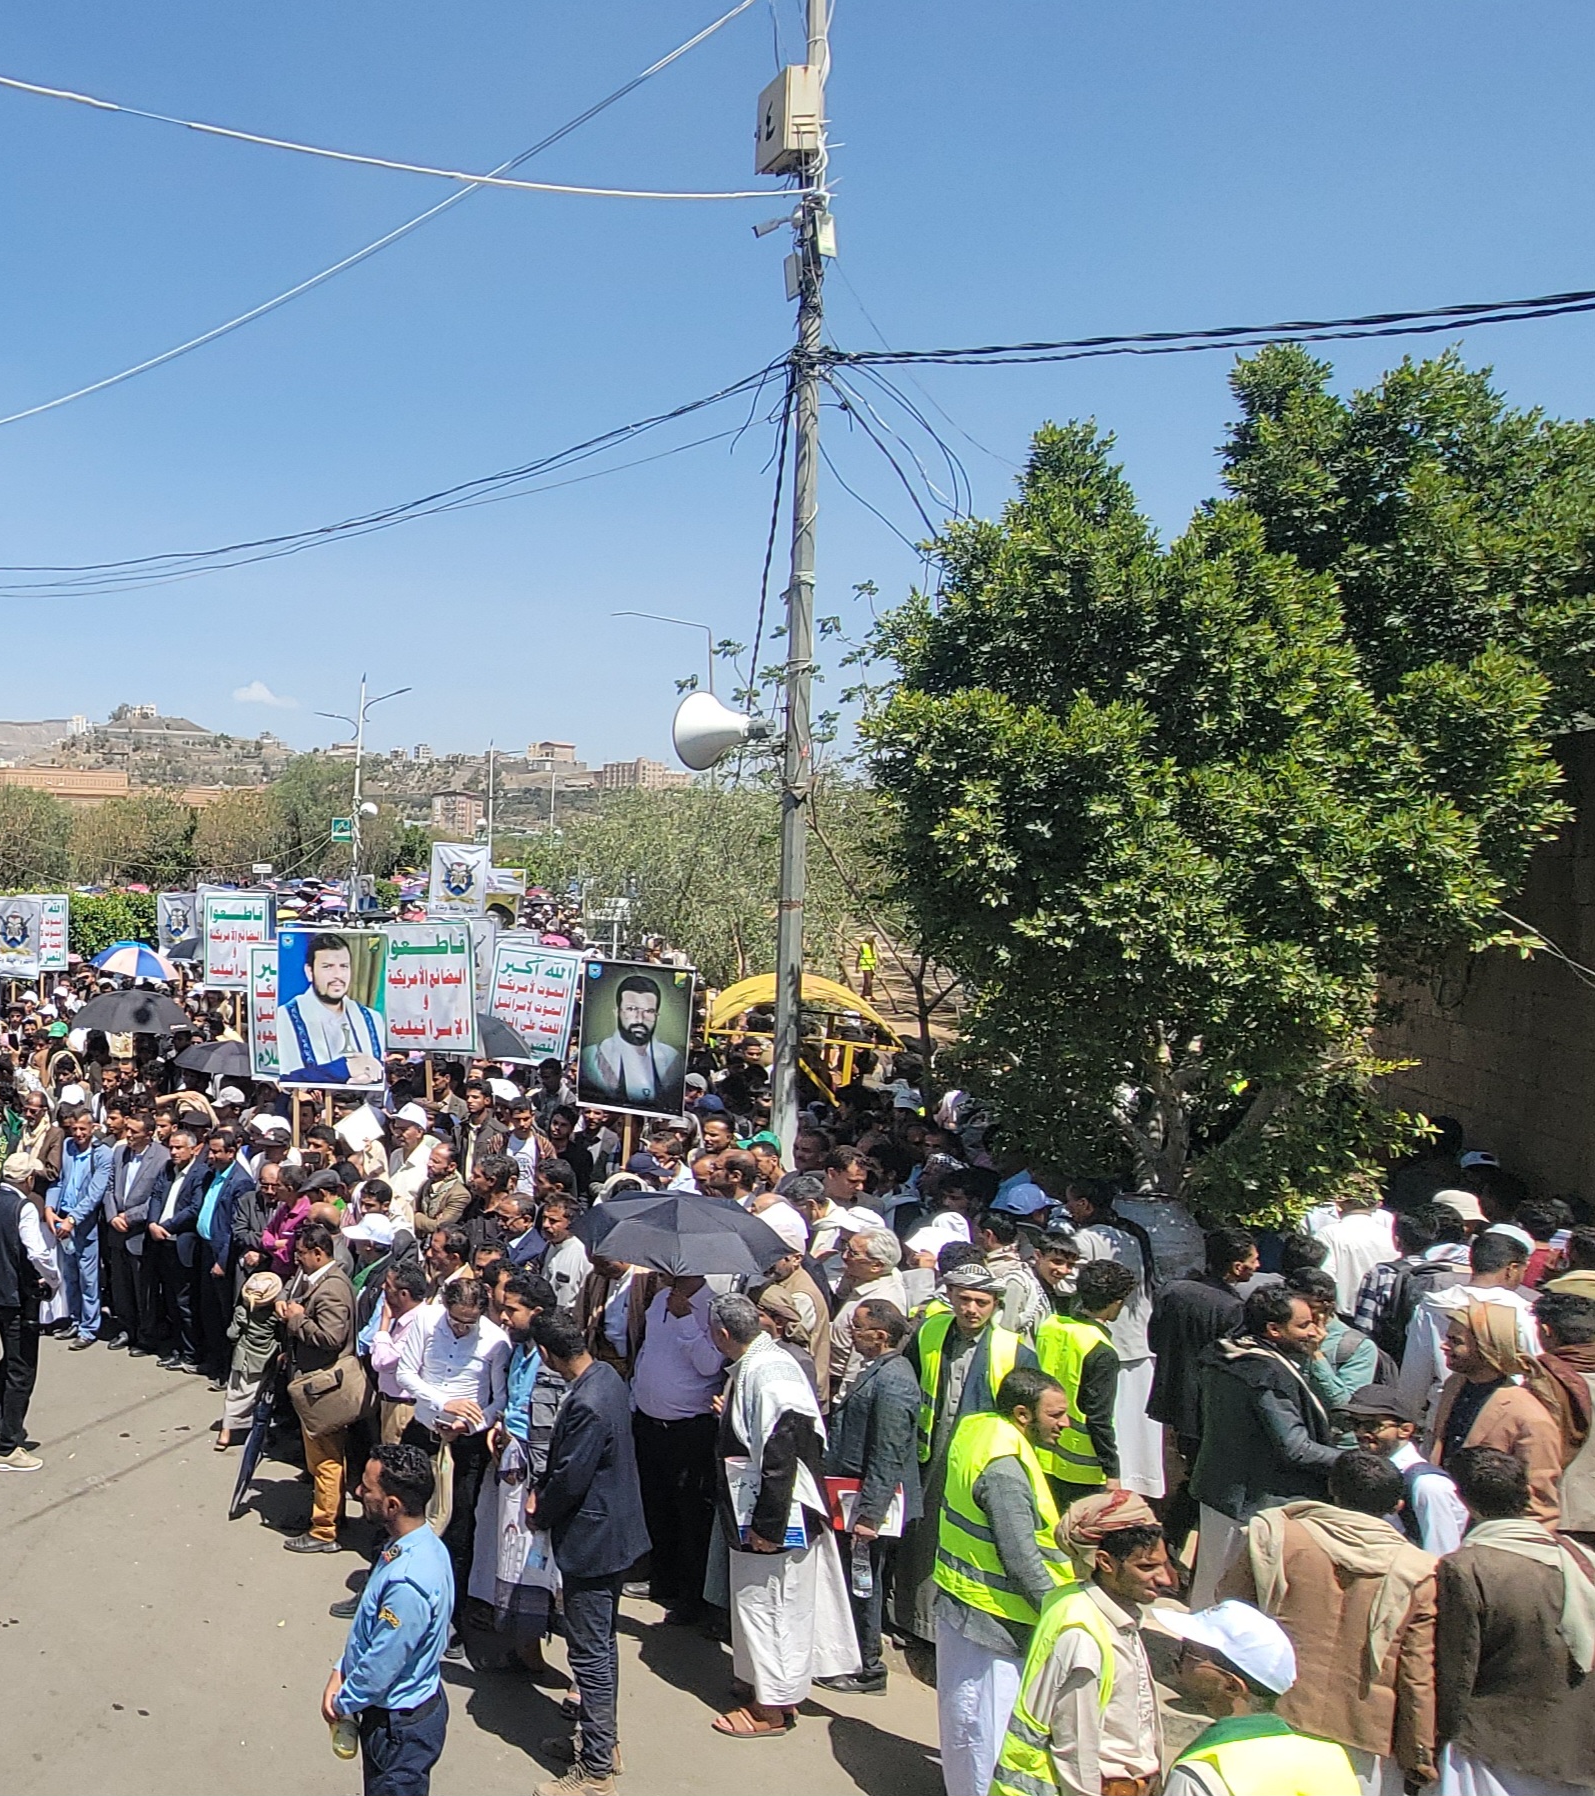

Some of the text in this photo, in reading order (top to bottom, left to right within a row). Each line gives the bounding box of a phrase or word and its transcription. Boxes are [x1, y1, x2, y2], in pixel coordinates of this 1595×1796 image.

[210, 905, 263, 923] قاطعوا
[499, 955, 572, 981] الله أكبر
[429, 967, 467, 989] البضائع
[537, 984, 569, 999] الموت
[422, 993, 429, 1010] و
[534, 1003, 566, 1017] الموت
[390, 1018, 469, 1041] الإسرائيلية
[520, 1018, 536, 1031] على
[538, 1019, 563, 1035] اللعنة
